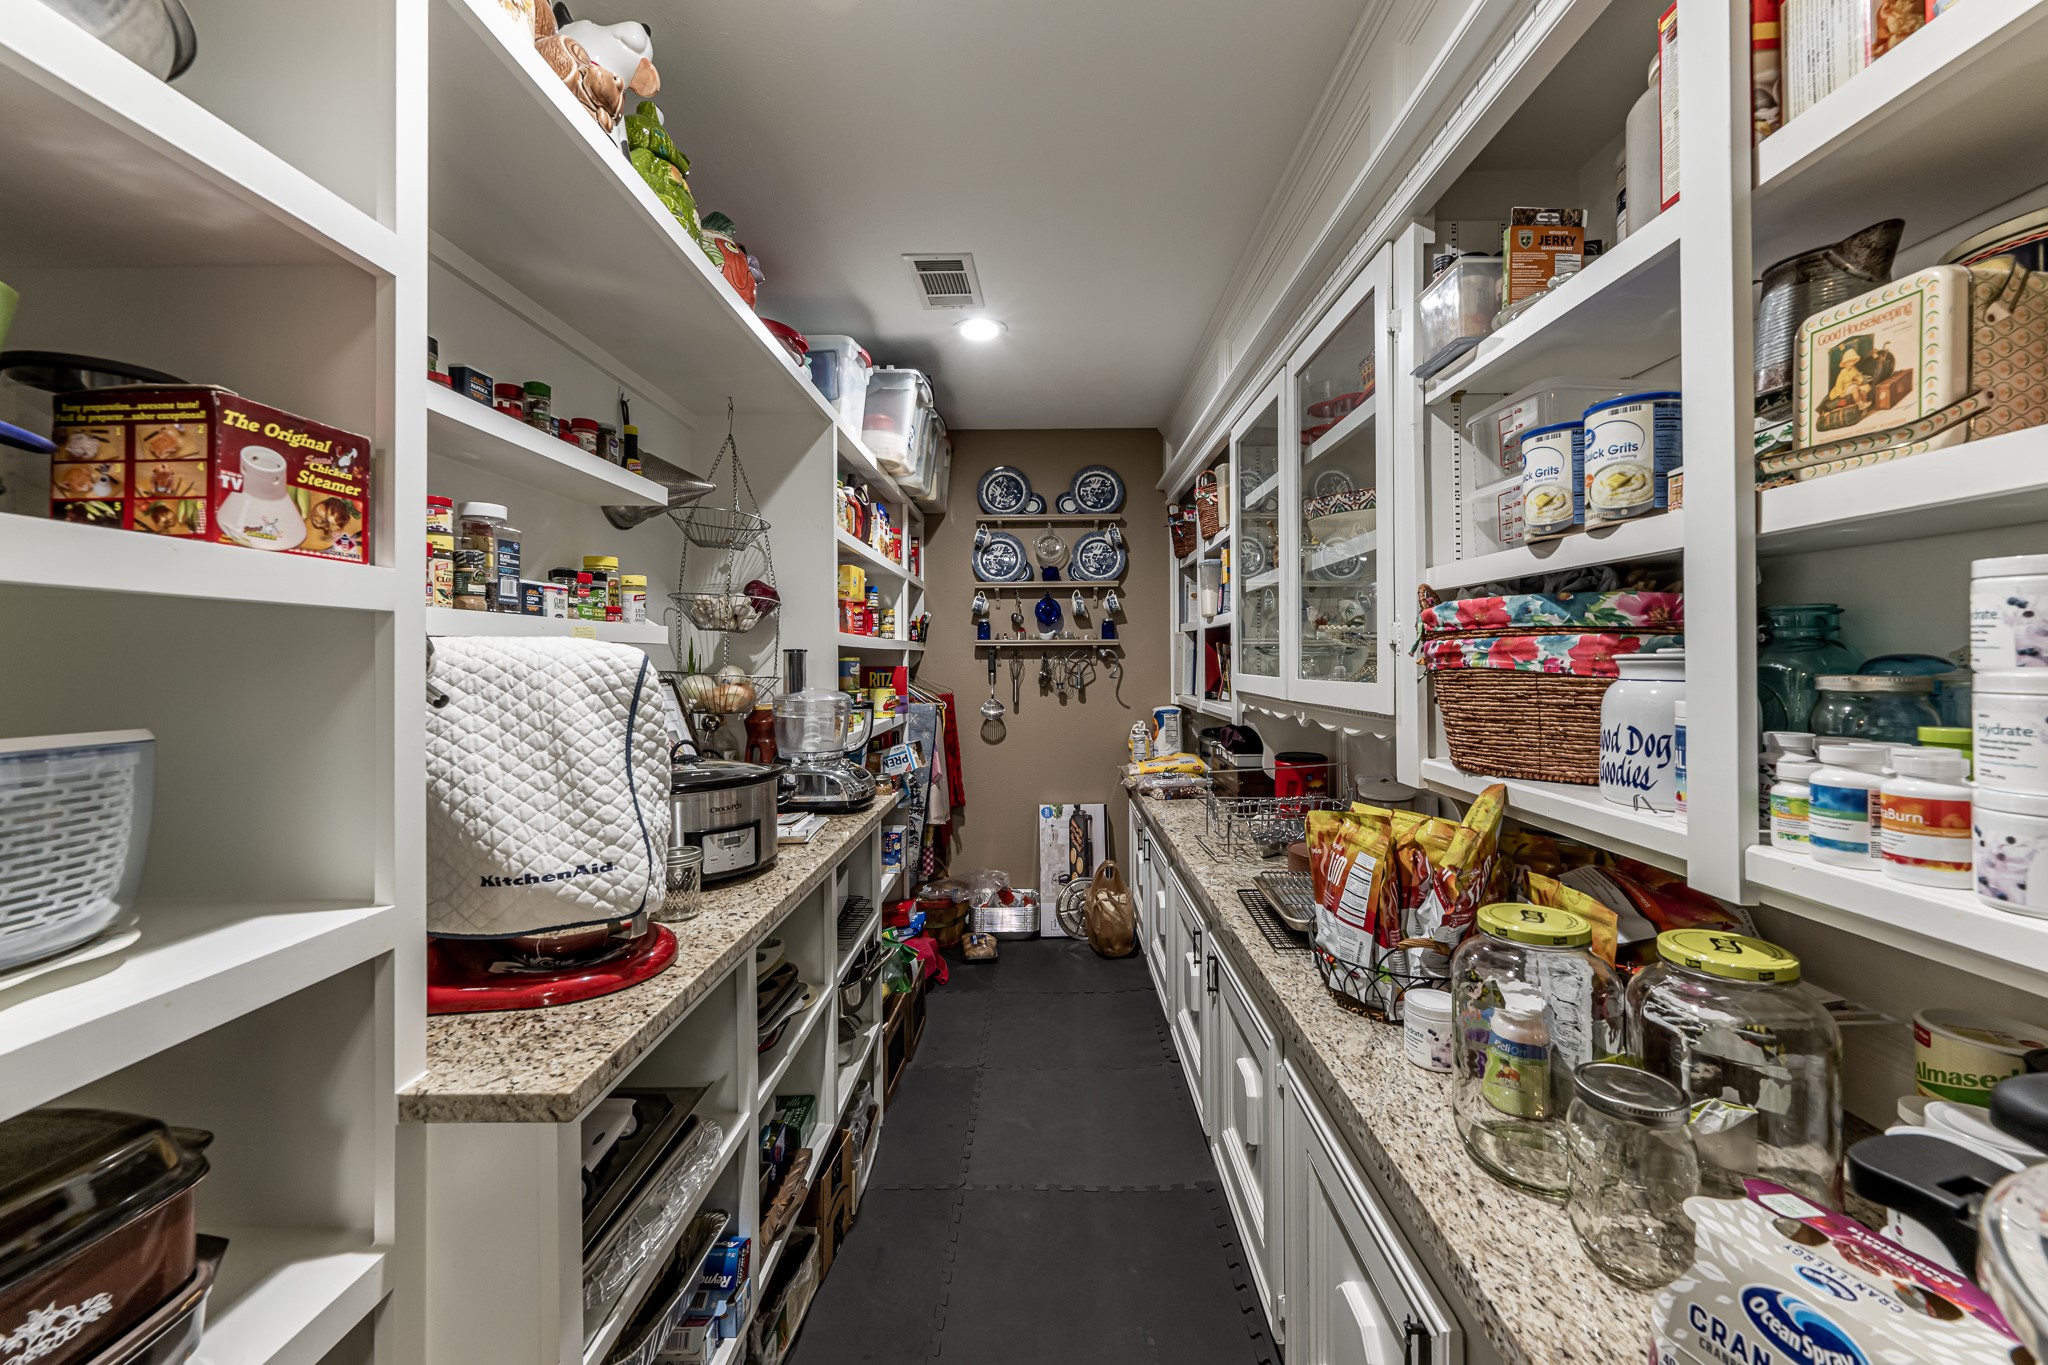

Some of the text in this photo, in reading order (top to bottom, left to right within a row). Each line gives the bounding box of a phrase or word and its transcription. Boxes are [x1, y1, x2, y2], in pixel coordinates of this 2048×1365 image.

[1538, 235, 1577, 246] JERKY
[1817, 302, 1913, 346] Good Housekeeping
[470, 382, 489, 395] PAPRIKA
[198, 425, 204, 433] 2
[223, 409, 332, 453] The Original
[1608, 442, 1638, 455] Grits
[115, 464, 121, 472] 3
[197, 463, 204, 471] 4
[309, 462, 353, 480] Chicken
[1535, 466, 1559, 477] Grits
[221, 475, 243, 491] TV
[297, 470, 361, 496] Steamer
[114, 501, 121, 511] 5
[868, 671, 893, 688] RITZ
[1978, 723, 2033, 737] Hydrate
[1625, 725, 1673, 769] Dog
[1600, 755, 1658, 791] Goodies
[480, 862, 615, 887] KitchenAid
[1689, 1304, 1772, 1365] CRAN
[1750, 1296, 1800, 1351] Ocean
